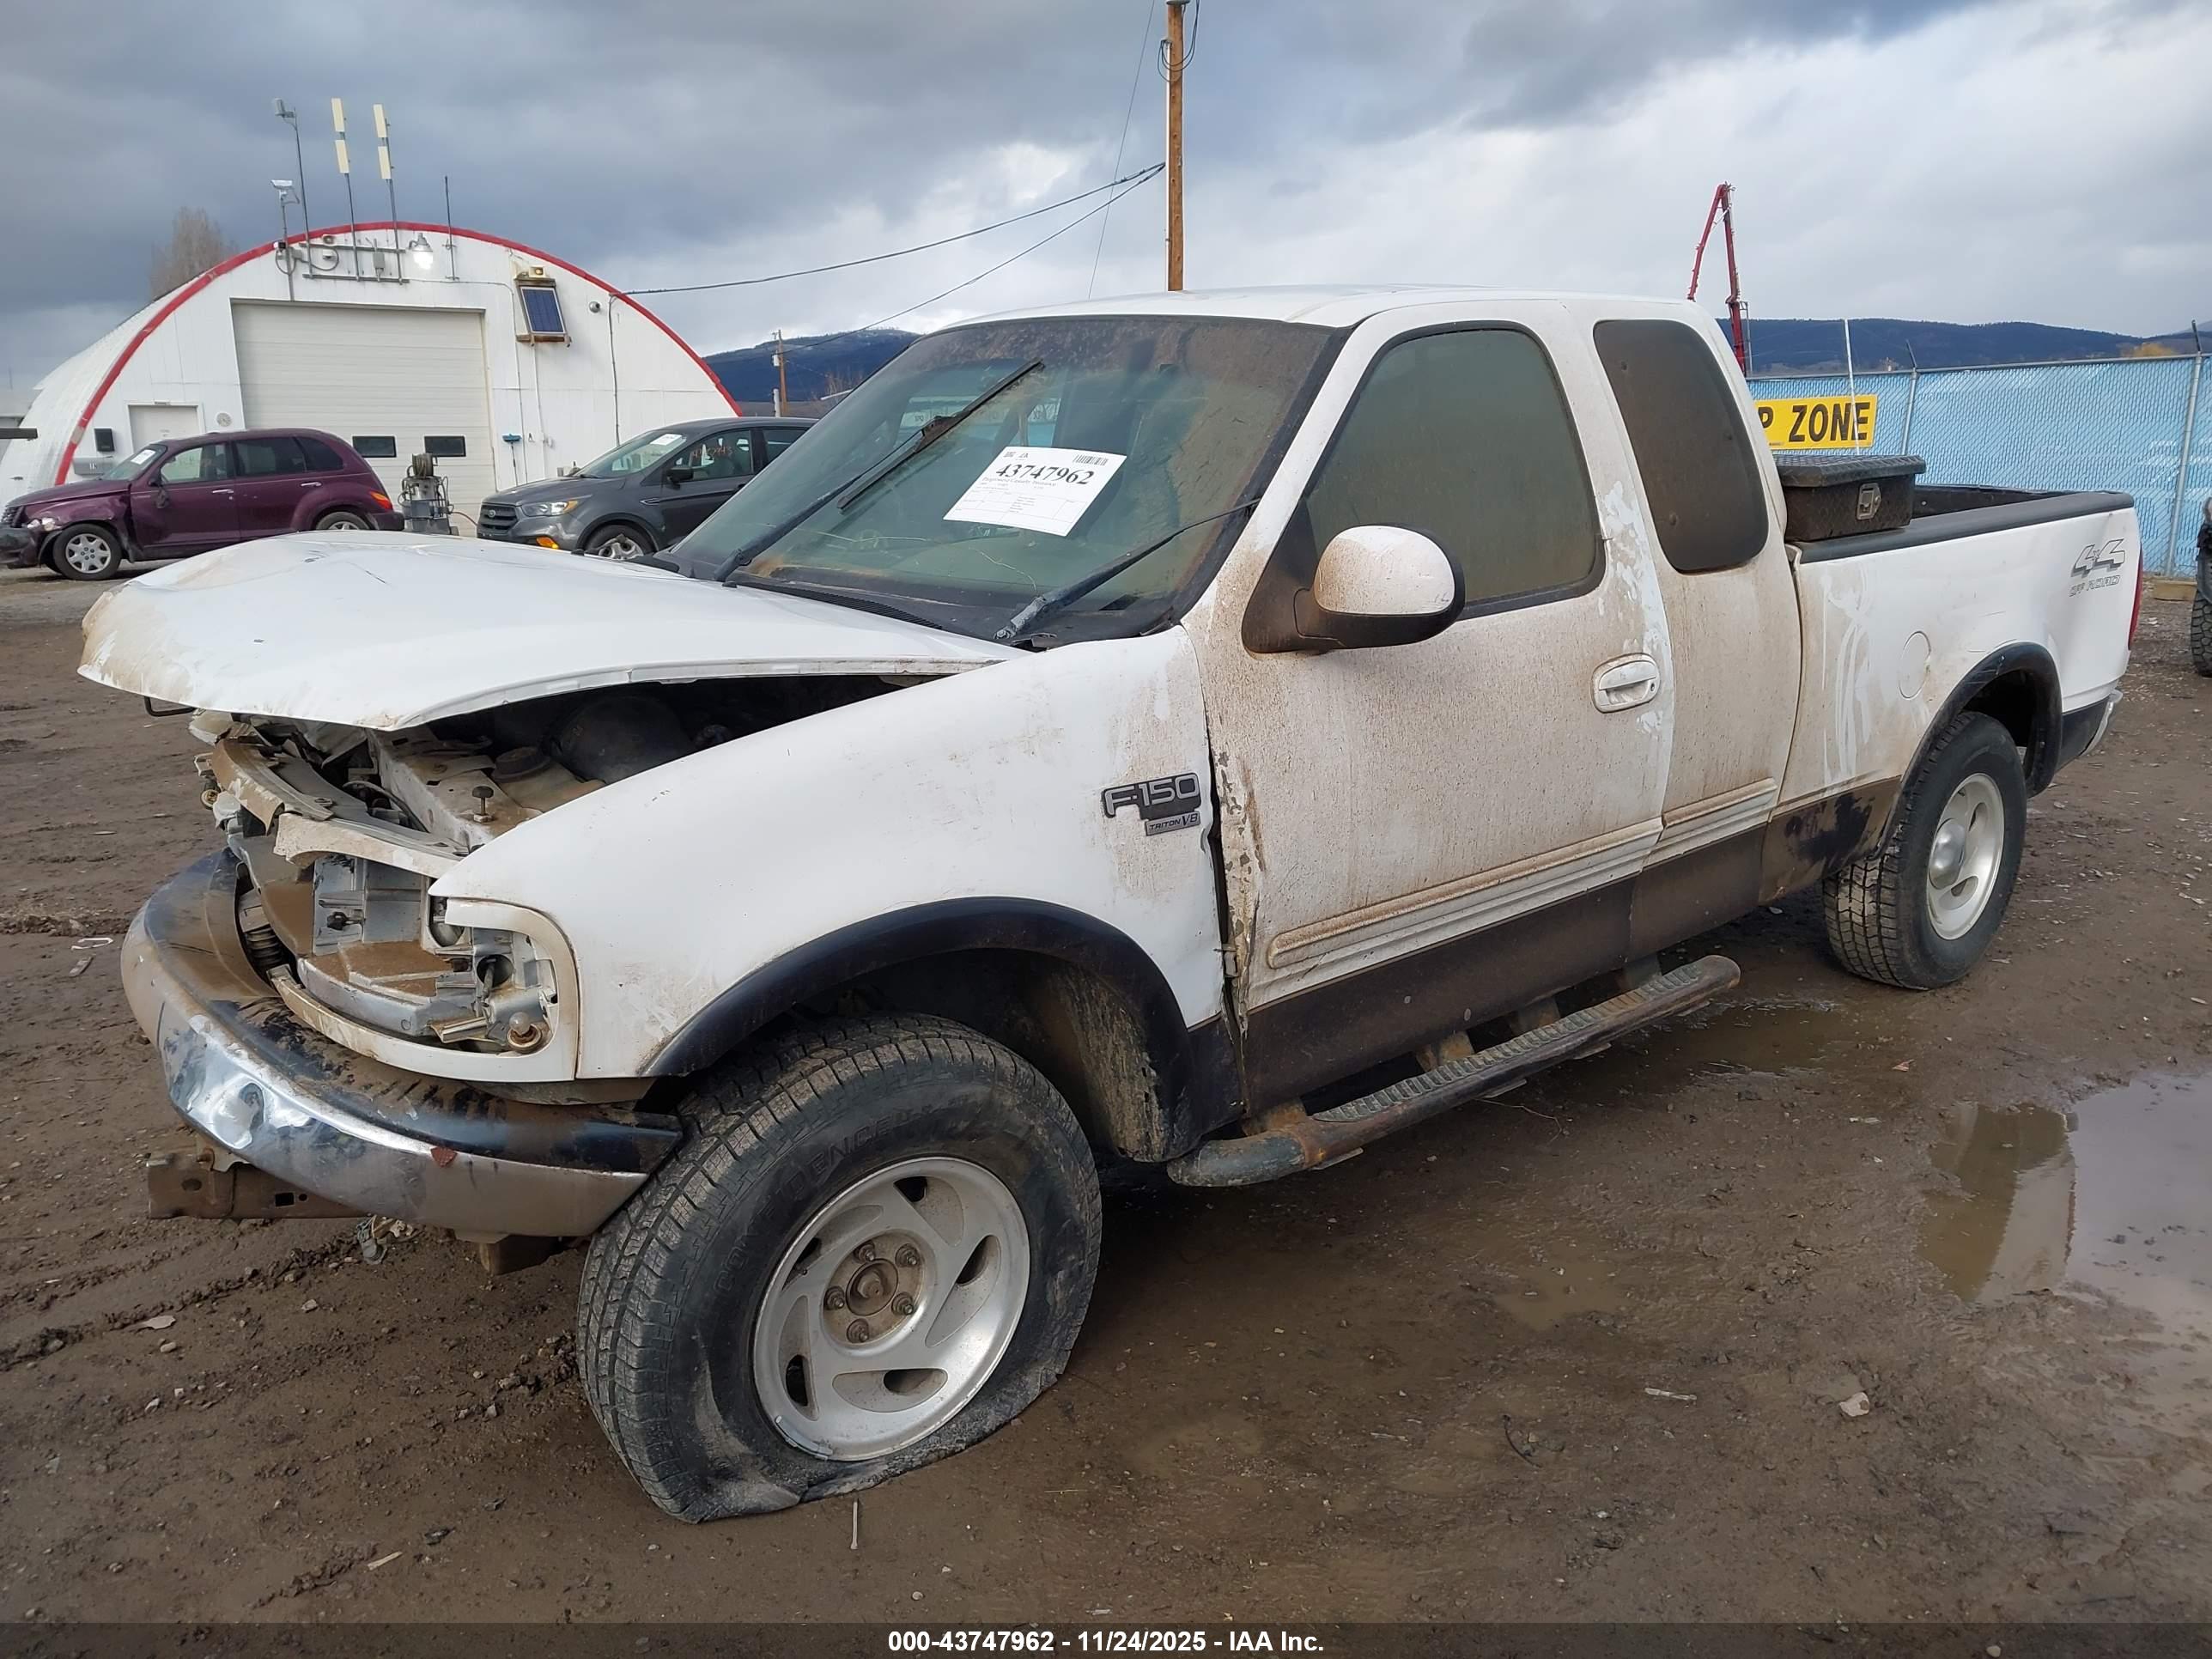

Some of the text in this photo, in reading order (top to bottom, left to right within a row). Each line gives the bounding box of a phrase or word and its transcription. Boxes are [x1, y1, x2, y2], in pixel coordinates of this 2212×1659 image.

[1789, 402, 1870, 442] ZONE
[995, 463, 1096, 486] 43747962
[2070, 538, 2126, 580] 4x4
[2087, 574, 2122, 592] ROAD
[1104, 773, 1200, 817] F-150
[1148, 812, 1199, 831] TRITON V8
